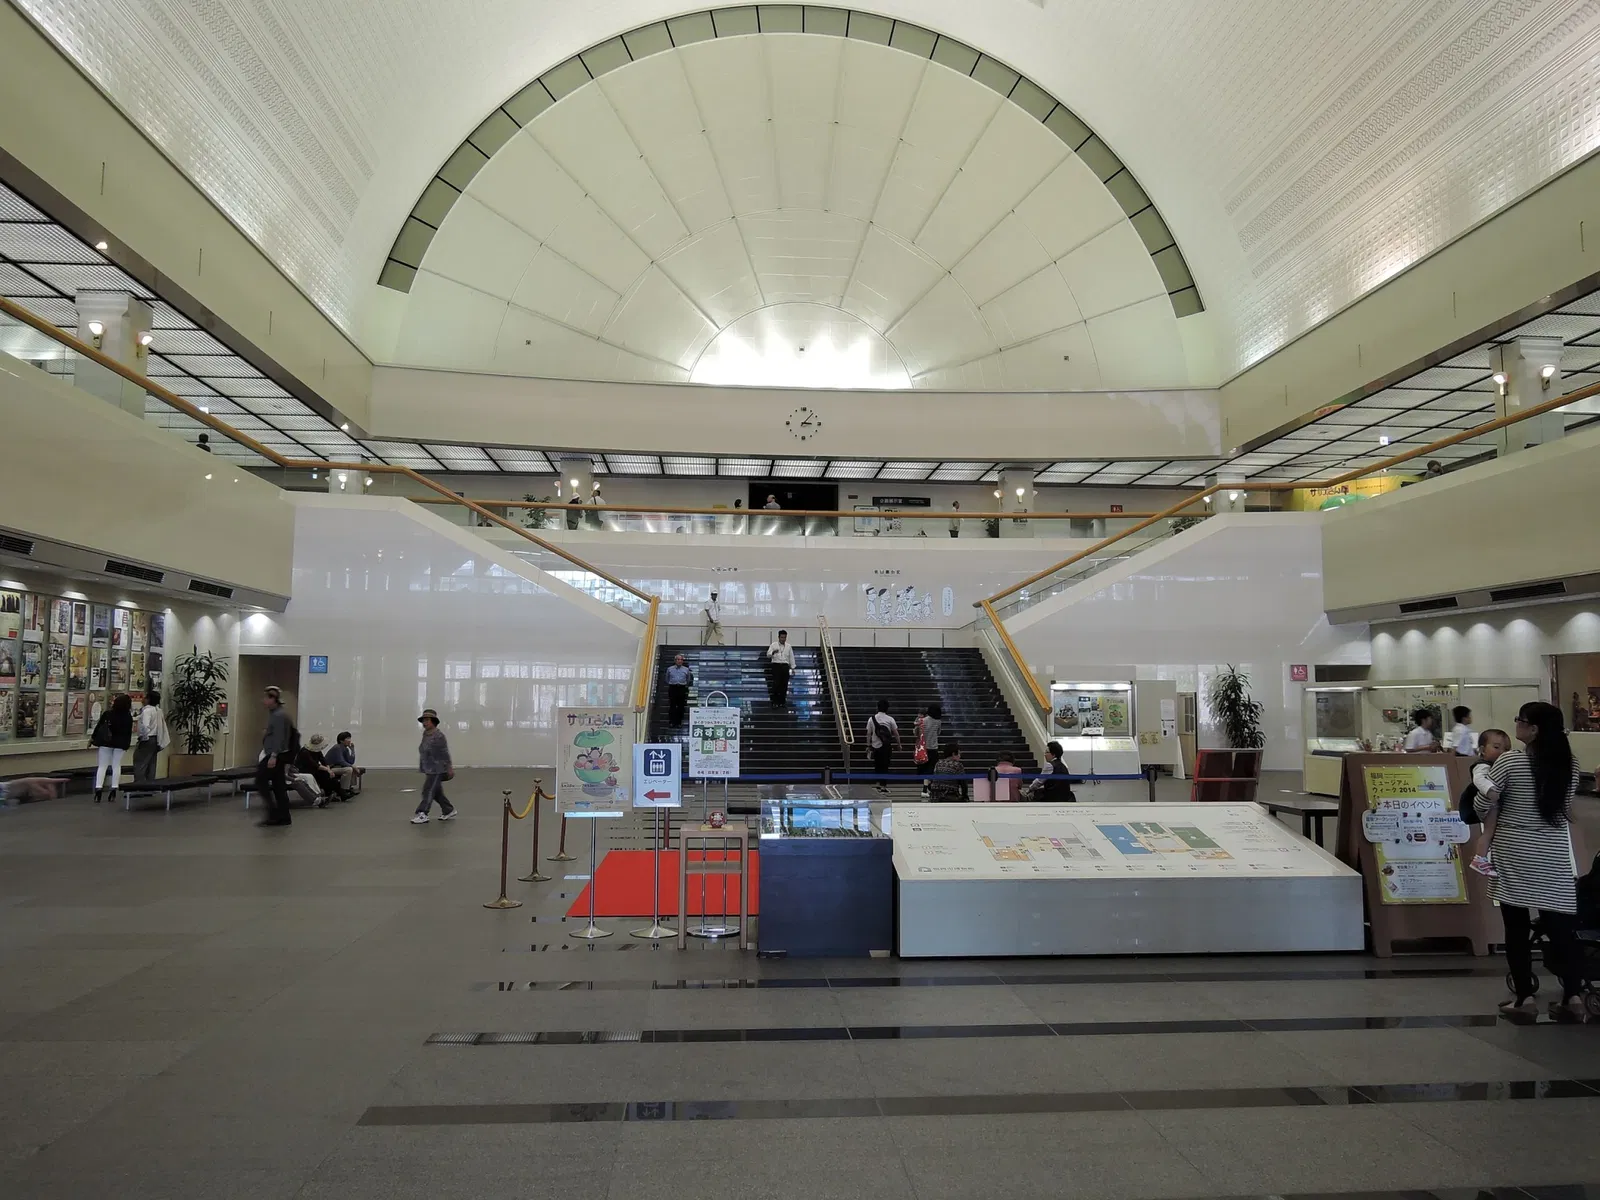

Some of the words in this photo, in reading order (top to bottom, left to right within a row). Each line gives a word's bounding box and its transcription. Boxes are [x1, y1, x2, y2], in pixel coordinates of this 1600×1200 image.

[693, 727, 736, 738] おすすめ
[1383, 800, 1441, 810] 本日のイベント
